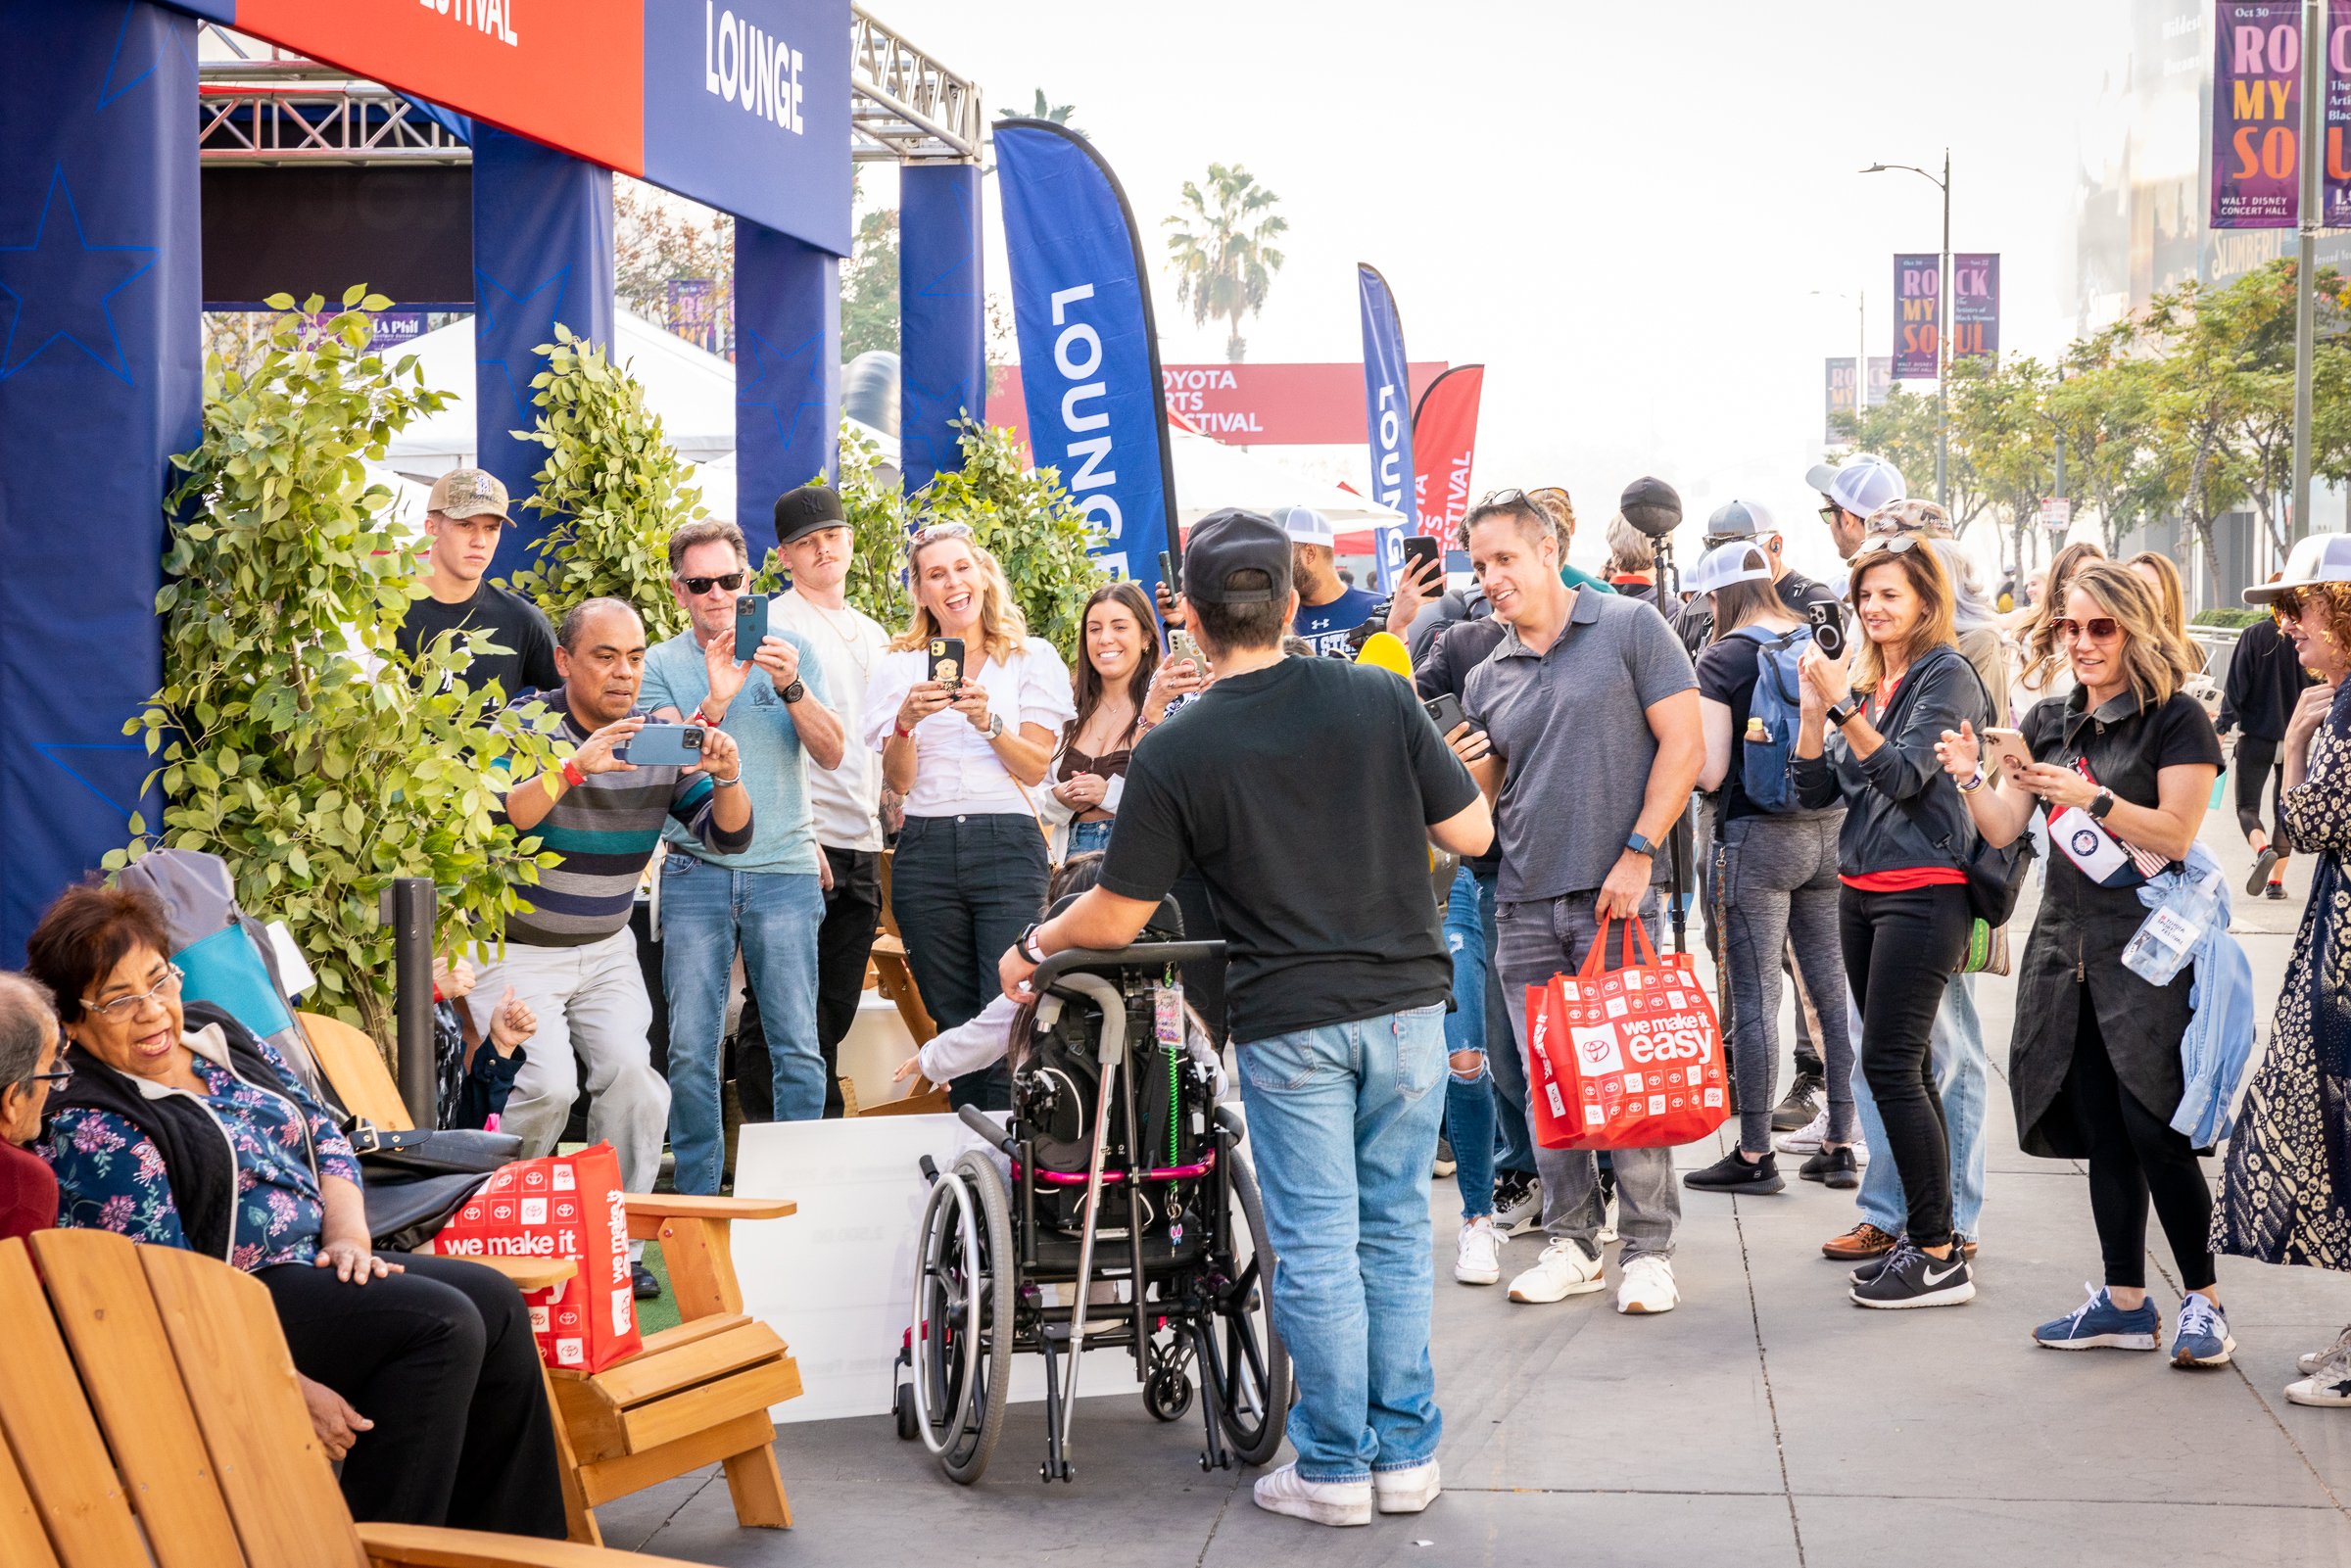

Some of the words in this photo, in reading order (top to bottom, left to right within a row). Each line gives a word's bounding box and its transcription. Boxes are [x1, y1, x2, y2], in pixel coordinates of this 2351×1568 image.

[2235, 8, 2253, 18] Oct
[2255, 8, 2270, 17] 30
[2234, 24, 2298, 73] RO
[705, 0, 803, 135] LOUNGE
[2233, 80, 2292, 119] MY
[2232, 126, 2295, 179] SO
[2221, 197, 2247, 206] WALT
[2252, 197, 2287, 206] DISNEY
[2221, 207, 2263, 215] CONCERT
[2265, 207, 2288, 215] HALL
[1903, 269, 1938, 296] RO
[1955, 269, 1988, 296] CK
[1903, 298, 1935, 321] MY
[392, 320, 418, 334] Phil
[1903, 324, 1938, 354] SO
[1954, 322, 1989, 354] UL
[1162, 370, 1237, 389] OYOTA
[1165, 392, 1204, 410] RTS
[1621, 1020, 1651, 1036] we
[1651, 1013, 1699, 1032] make
[1697, 1011, 1710, 1028] it
[1629, 1028, 1712, 1065] easy
[607, 1203, 623, 1254] make
[445, 1238, 483, 1255] we
[487, 1230, 554, 1256] make
[558, 1229, 577, 1254] it
[612, 1255, 624, 1284] we
